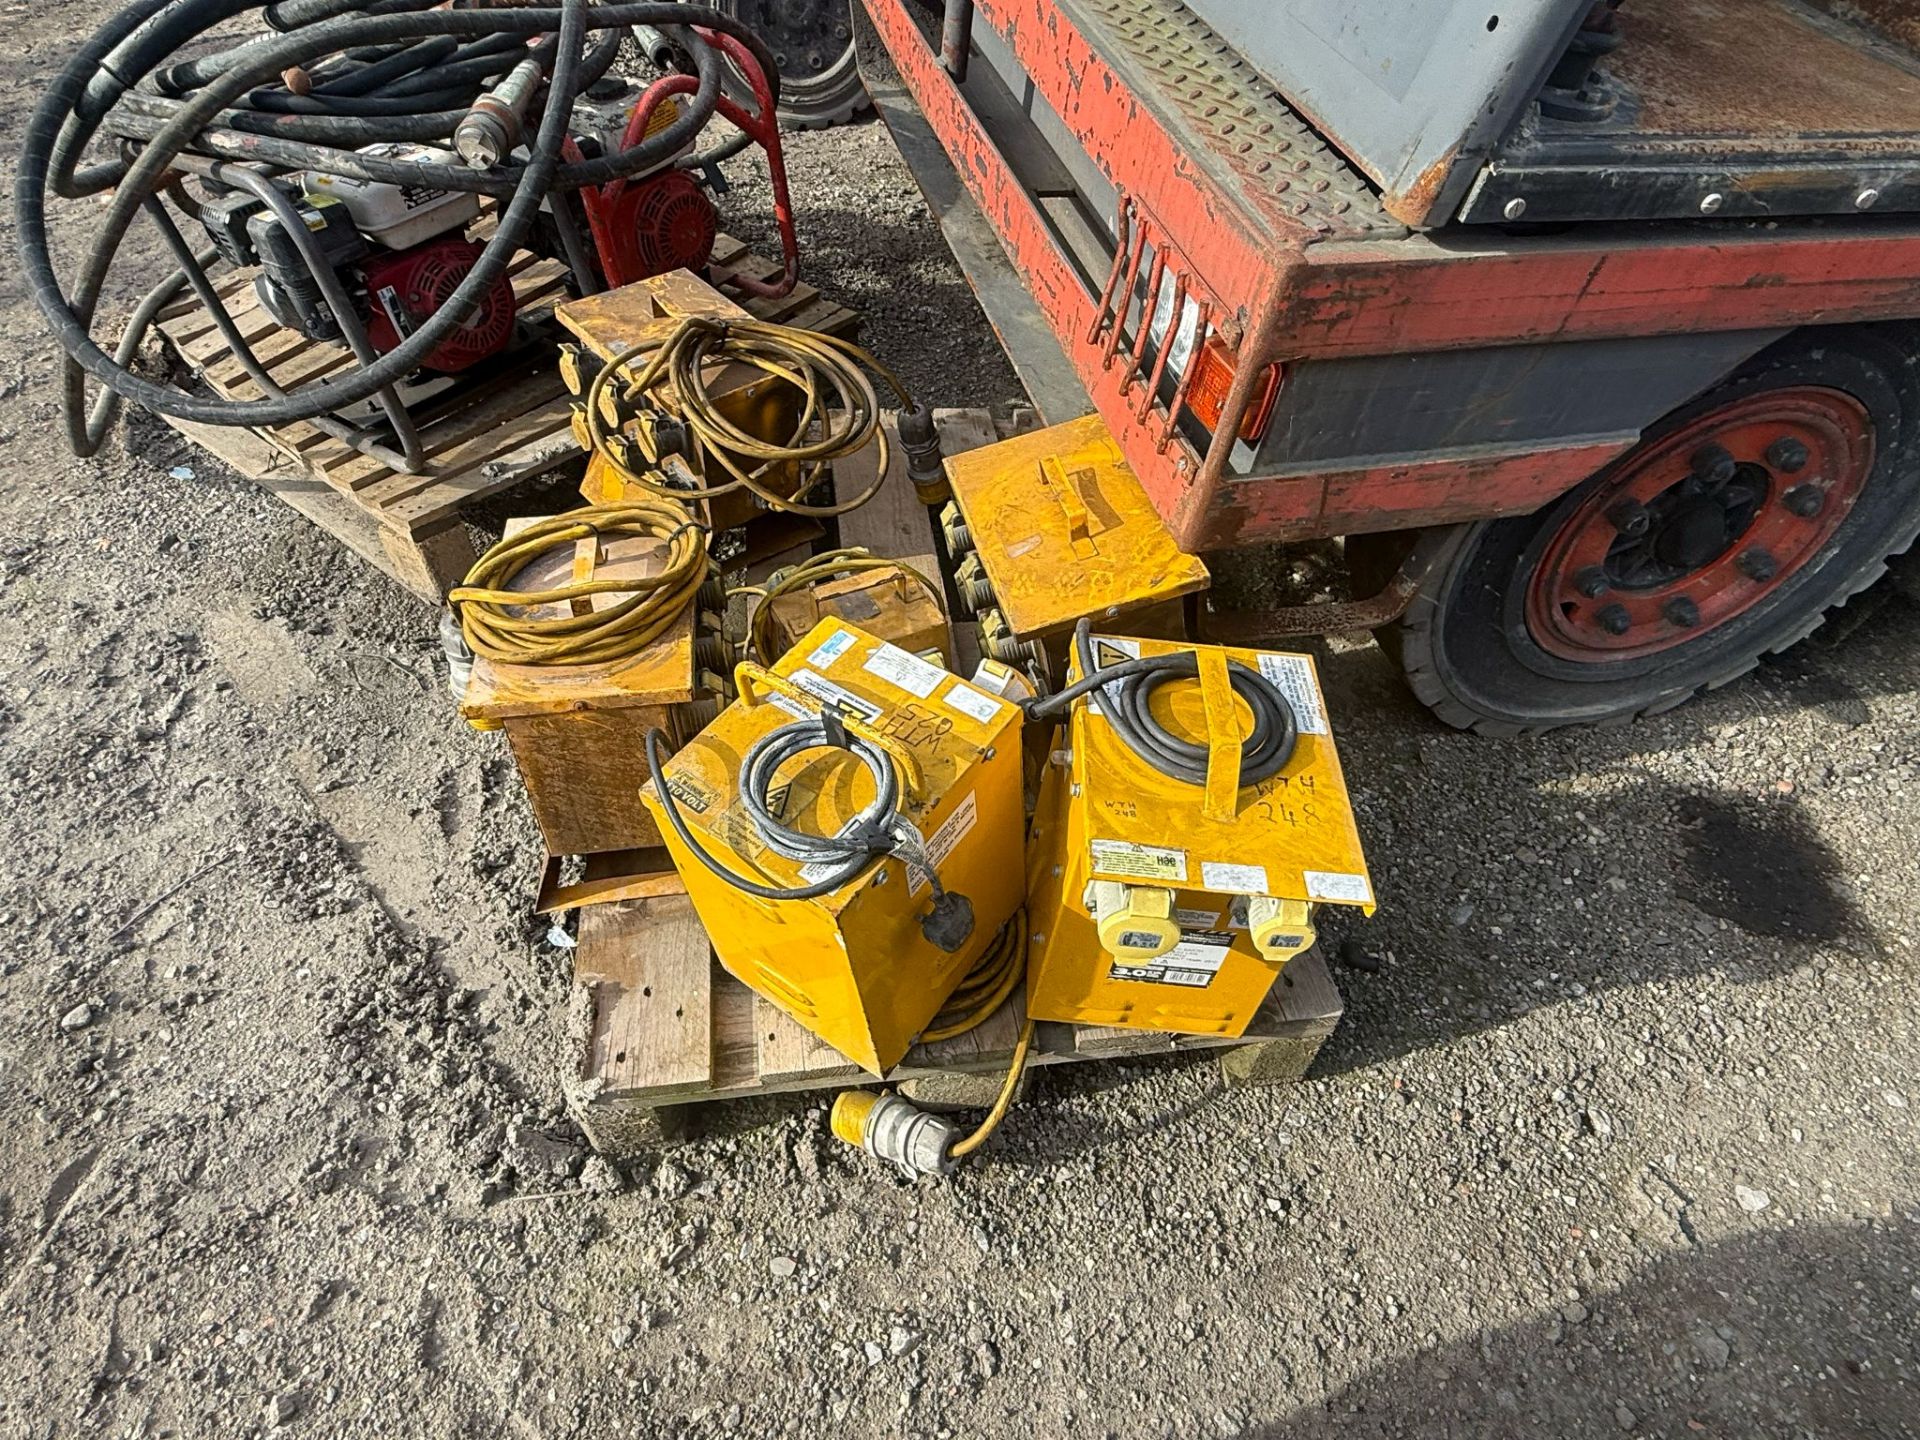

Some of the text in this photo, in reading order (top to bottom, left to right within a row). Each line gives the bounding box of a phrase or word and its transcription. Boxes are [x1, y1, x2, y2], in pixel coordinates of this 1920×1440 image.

[896, 703, 953, 736] 025
[881, 716, 941, 755] WTH
[682, 792, 708, 812] VOLT
[1104, 800, 1136, 809] WTH
[1258, 801, 1323, 827] 248
[1113, 966, 1147, 977] 3.0
